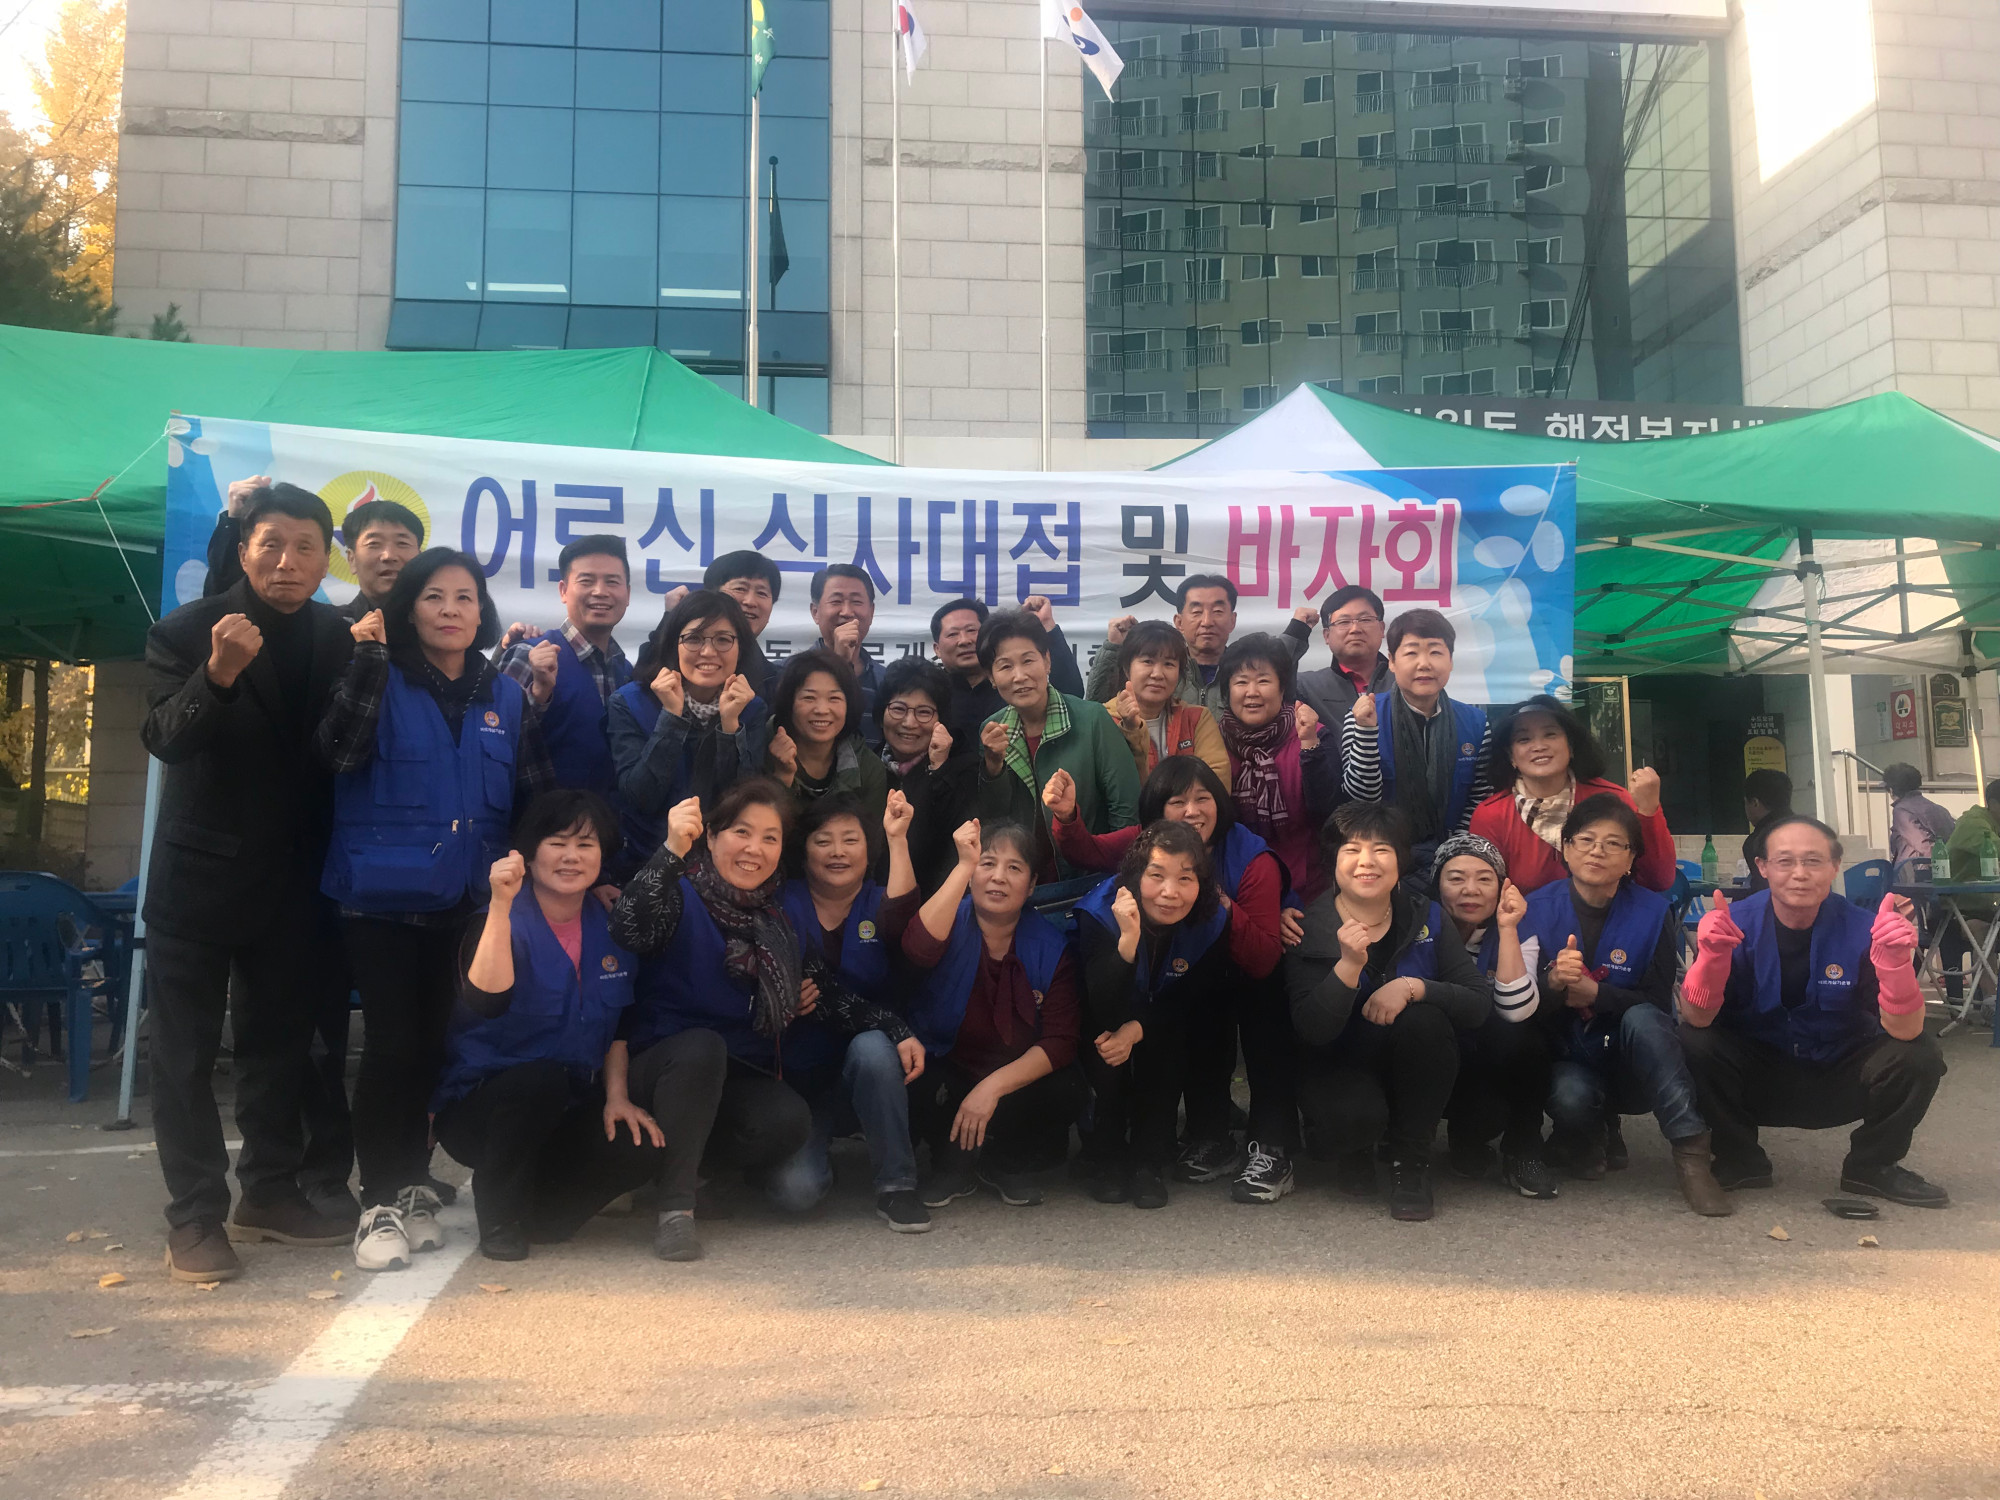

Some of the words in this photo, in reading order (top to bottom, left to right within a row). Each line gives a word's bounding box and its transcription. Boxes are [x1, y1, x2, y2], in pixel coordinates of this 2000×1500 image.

[461, 476, 715, 594] 어르신
[752, 493, 1081, 606] 식사대접
[1119, 504, 1189, 608] 및
[1226, 503, 1456, 609] 바자회
[1942, 683, 1956, 696] 51
